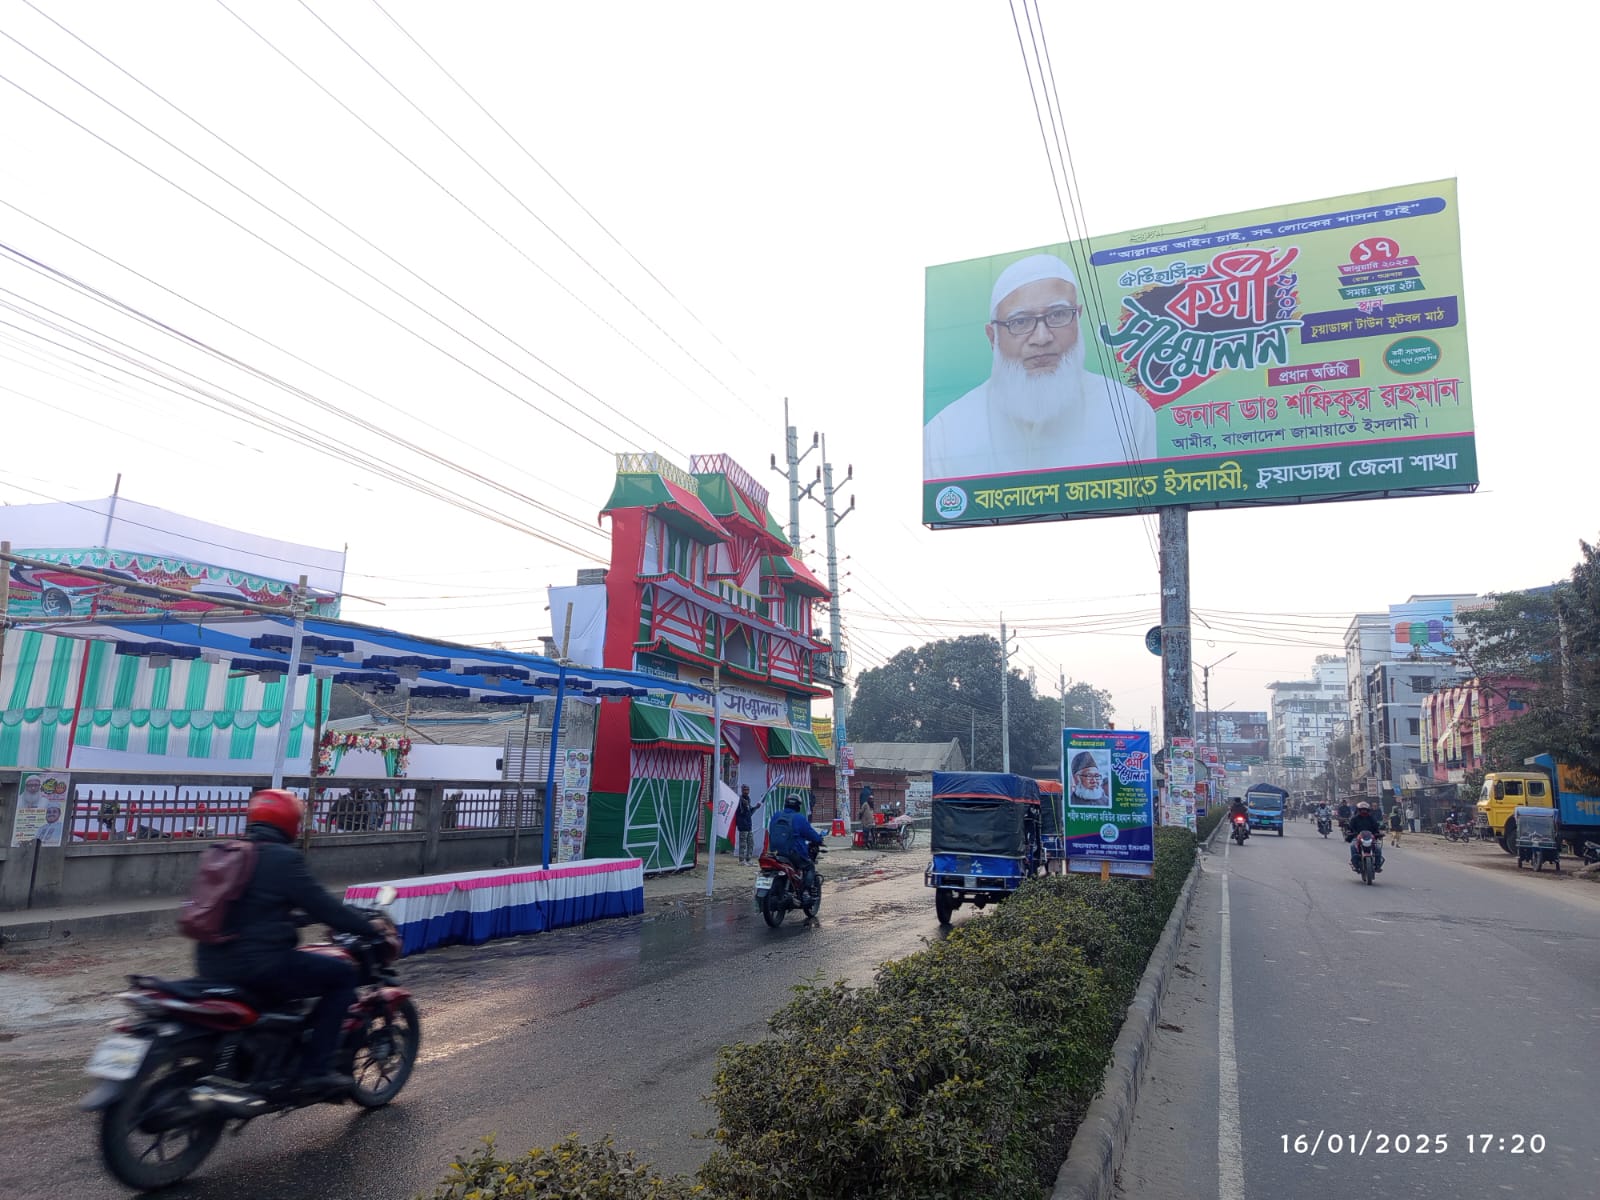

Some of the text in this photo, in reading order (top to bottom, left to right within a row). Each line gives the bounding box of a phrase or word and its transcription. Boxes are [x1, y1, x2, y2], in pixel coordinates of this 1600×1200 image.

[1173, 237, 1210, 249] আইন
[1252, 227, 1272, 237] সৎ
[1278, 219, 1331, 234] লোকের
[1337, 210, 1378, 223] শাসন
[1358, 241, 1393, 261] ১৭
[1119, 262, 1207, 287] ঐতিহাসিক
[1166, 248, 1299, 327] কর্মী
[1311, 307, 1445, 338] চুয়াডাঙ্গা টাউন ফুটবল মাঠ
[1356, 299, 1384, 314] স্থান
[1099, 296, 1304, 394] সম্মেলন
[1278, 364, 1349, 383] প্রধান অতিথি
[1170, 377, 1464, 428] জনাব ডাঃ শফিকুর রহমান
[1172, 433, 1217, 451] আমীর,
[1222, 428, 1285, 448] বাংলাদেশ
[1290, 419, 1357, 440] জামায়াতে
[1363, 413, 1420, 432] ইসলামী
[974, 451, 1458, 510] বাংলাদেশ জামায়াতে ইসলামী, চুয়াডাঙ্গা জেলা শাখা
